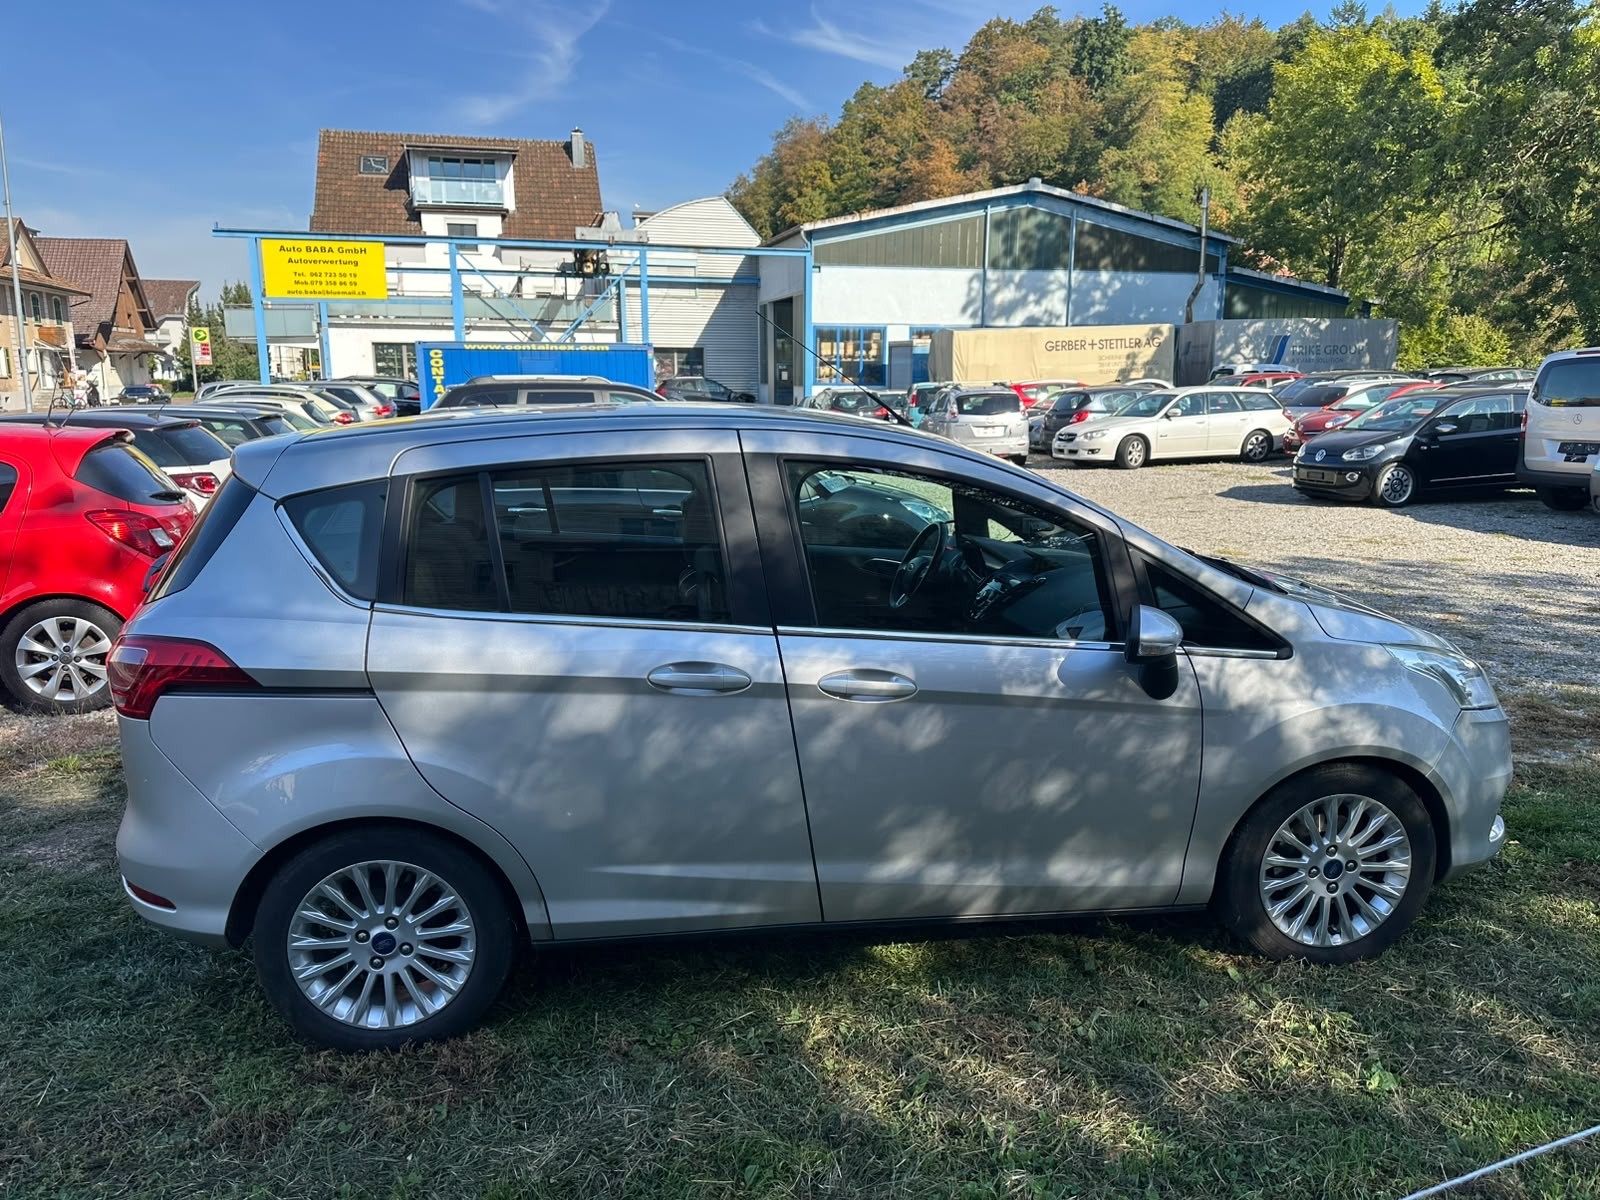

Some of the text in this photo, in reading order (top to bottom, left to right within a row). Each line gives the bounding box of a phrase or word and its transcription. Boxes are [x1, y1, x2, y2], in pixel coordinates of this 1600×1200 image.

[279, 245, 367, 255] Auto BABA GmbH
[288, 257, 359, 267] Autoverwertung
[464, 343, 610, 351] www.containex.com
[1143, 337, 1161, 348] AG
[1323, 344, 1364, 356] GROUP
[429, 349, 446, 398] CONTA
